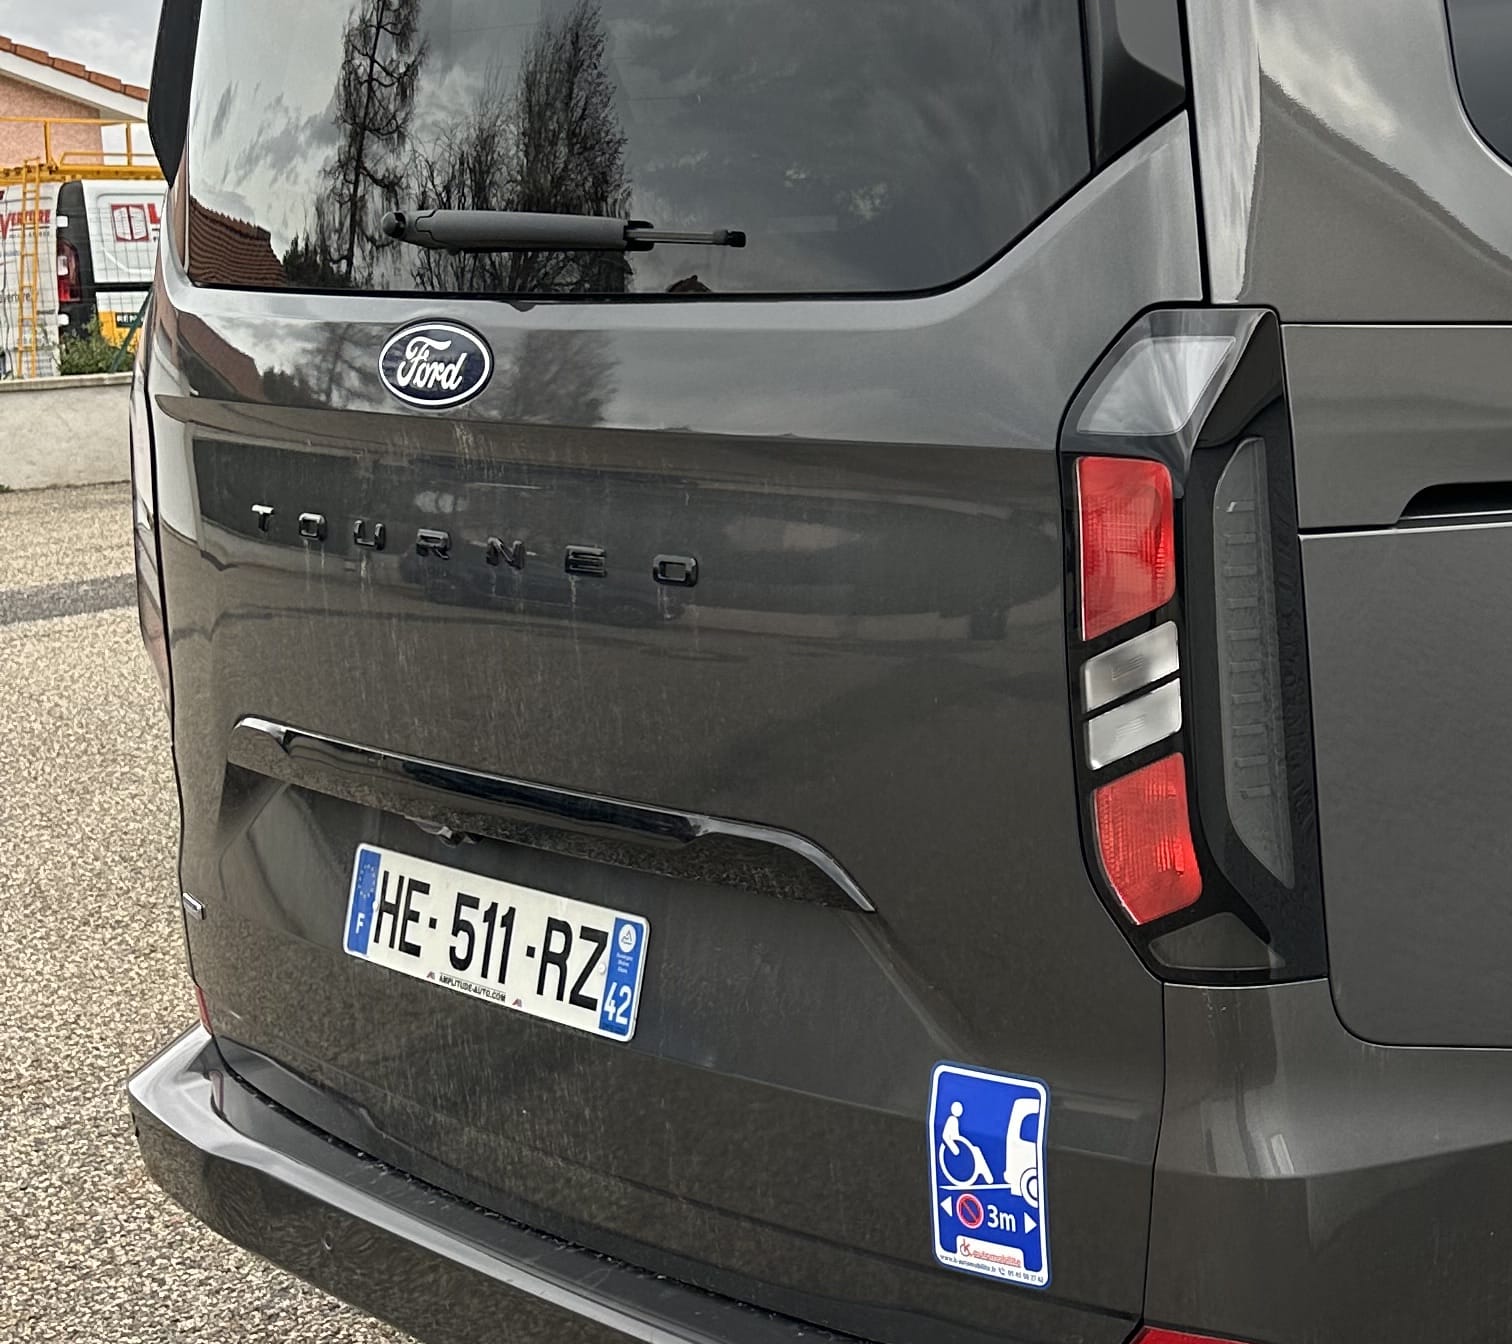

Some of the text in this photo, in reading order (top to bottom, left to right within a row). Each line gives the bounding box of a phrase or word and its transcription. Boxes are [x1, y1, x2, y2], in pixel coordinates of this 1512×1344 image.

[396, 335, 468, 391] Ford
[250, 503, 699, 588] TOURNEO
[354, 912, 366, 935] F
[603, 981, 632, 1025] 42
[987, 1204, 1017, 1233] 3m
